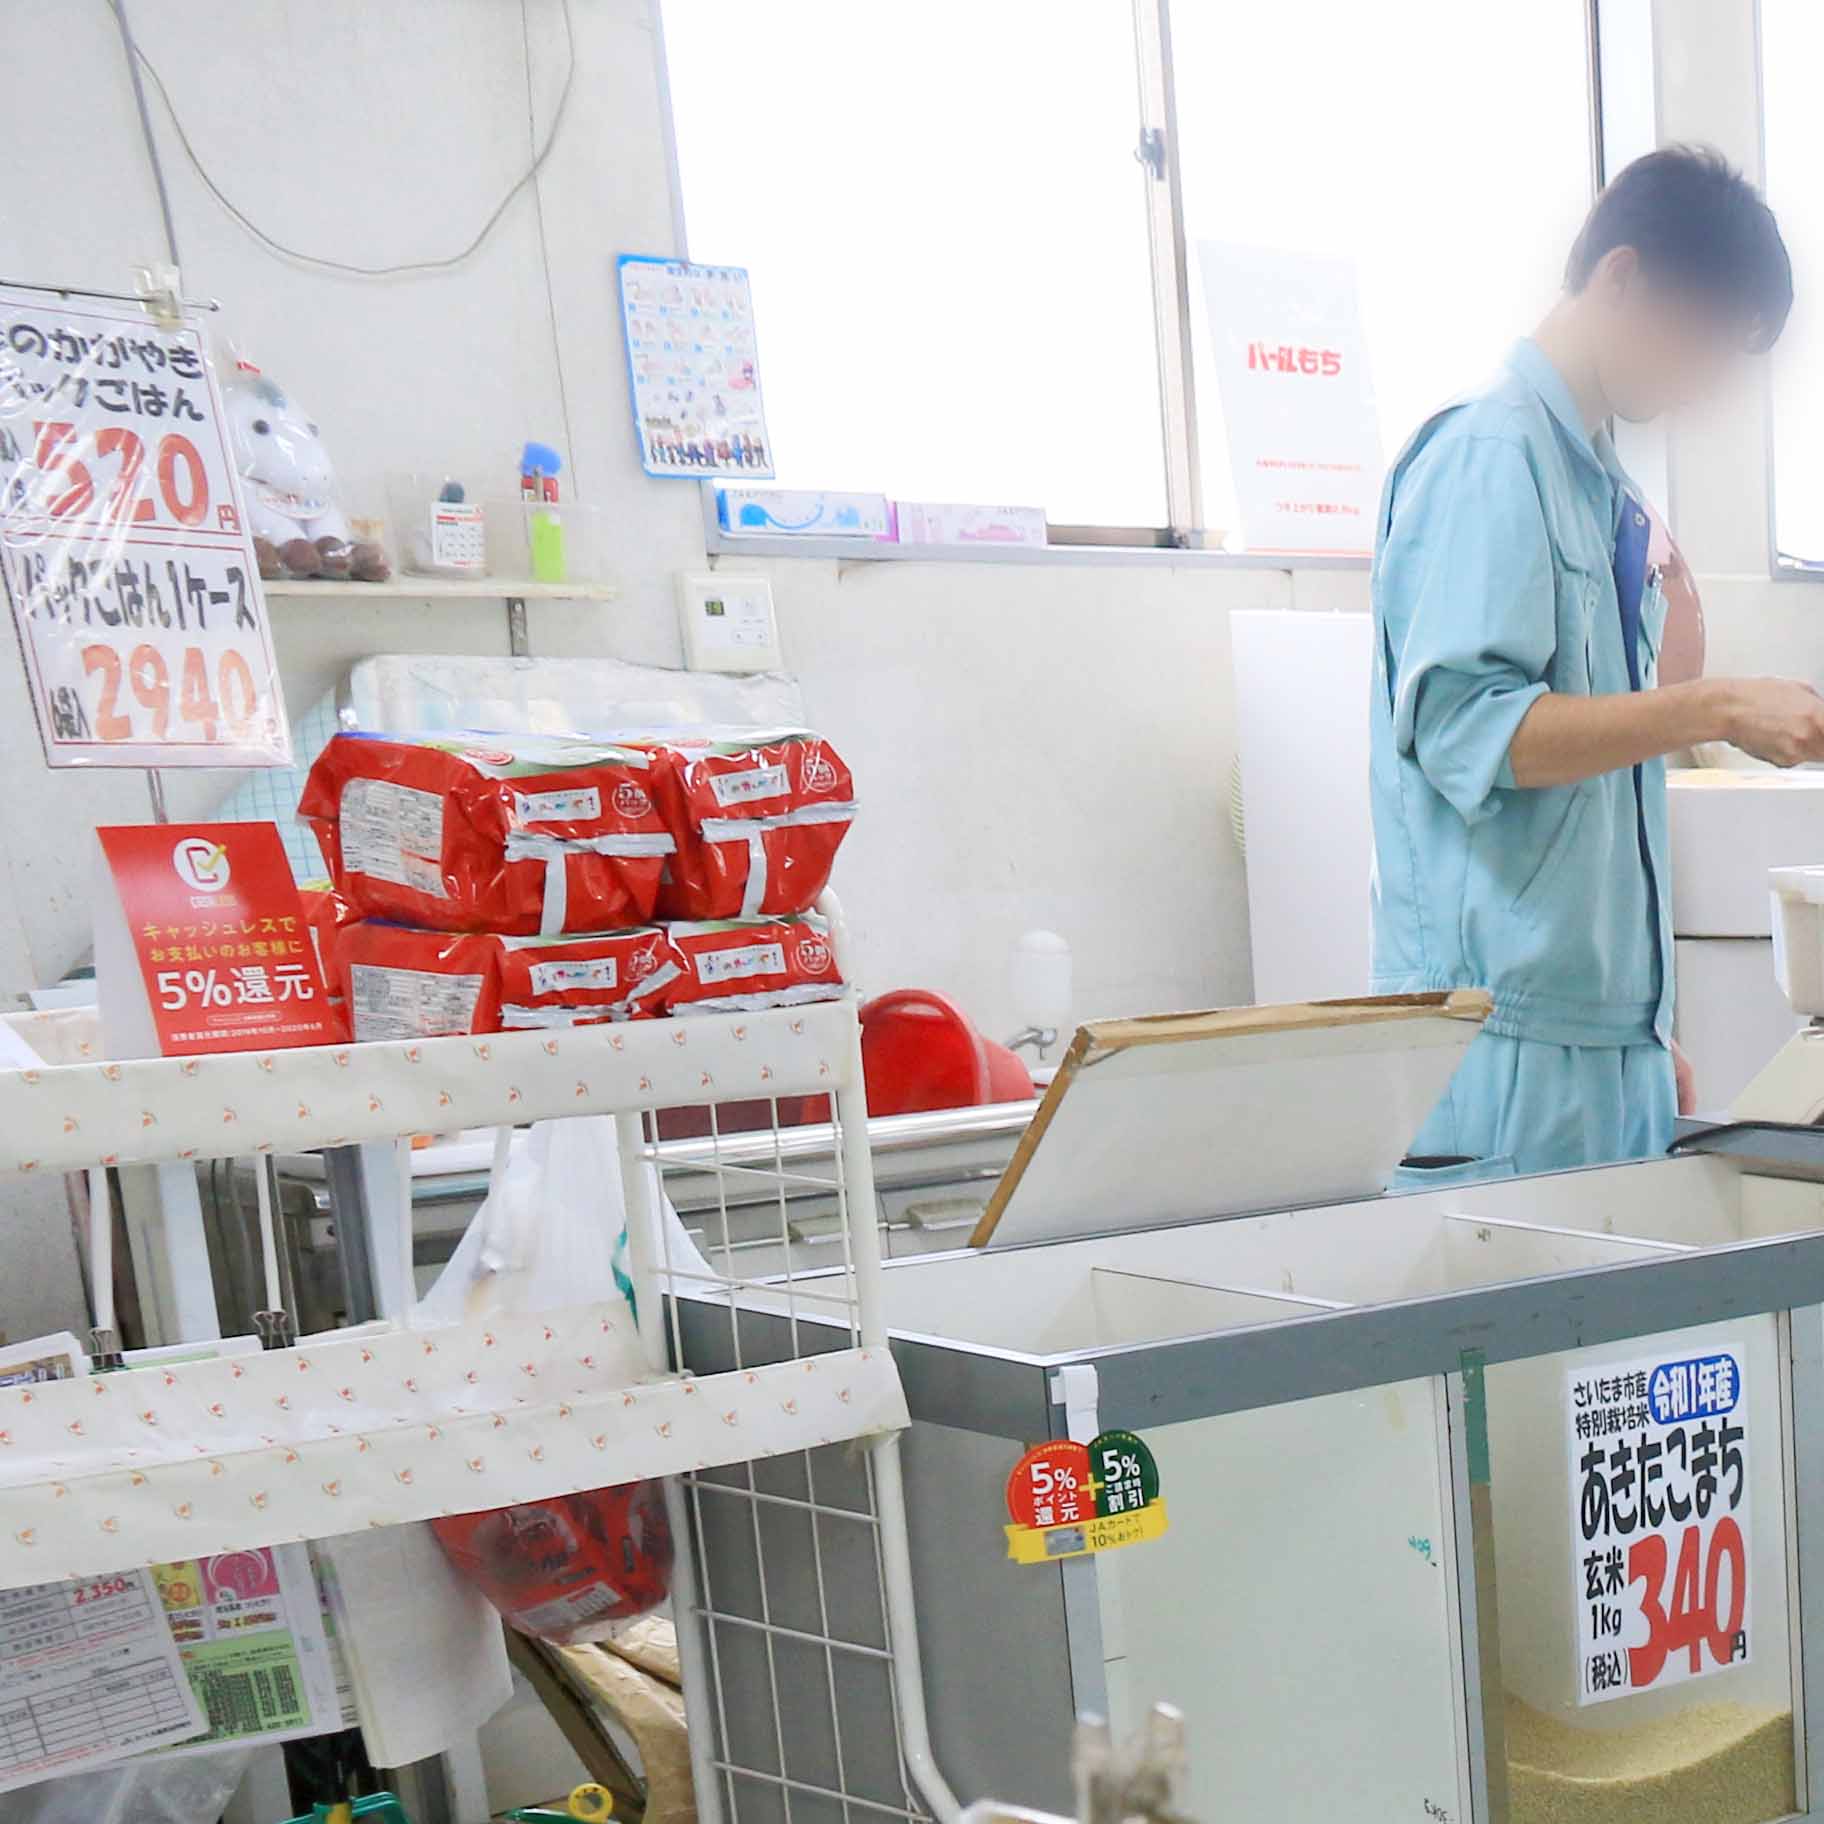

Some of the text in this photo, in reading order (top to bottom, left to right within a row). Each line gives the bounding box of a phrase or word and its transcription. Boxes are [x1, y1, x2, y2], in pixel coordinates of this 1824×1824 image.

[143, 916, 297, 941] キャッシュレスで
[152, 940, 304, 964] お支払いのお客様に
[157, 964, 314, 1011] 5%還元
[1573, 1369, 1649, 1408] さいたま市産
[1574, 1405, 1651, 1441] 特別栽培米
[1030, 1461, 1077, 1494] 5%
[1101, 1449, 1141, 1482] 5%
[1579, 1421, 1745, 1542] あきたこまち
[1034, 1504, 1080, 1526] 還元
[1107, 1490, 1144, 1513] 割引
[1583, 1550, 1626, 1601] 玄米
[1590, 1602, 1623, 1642] 1kg
[1583, 1646, 1630, 1693] (税込)
